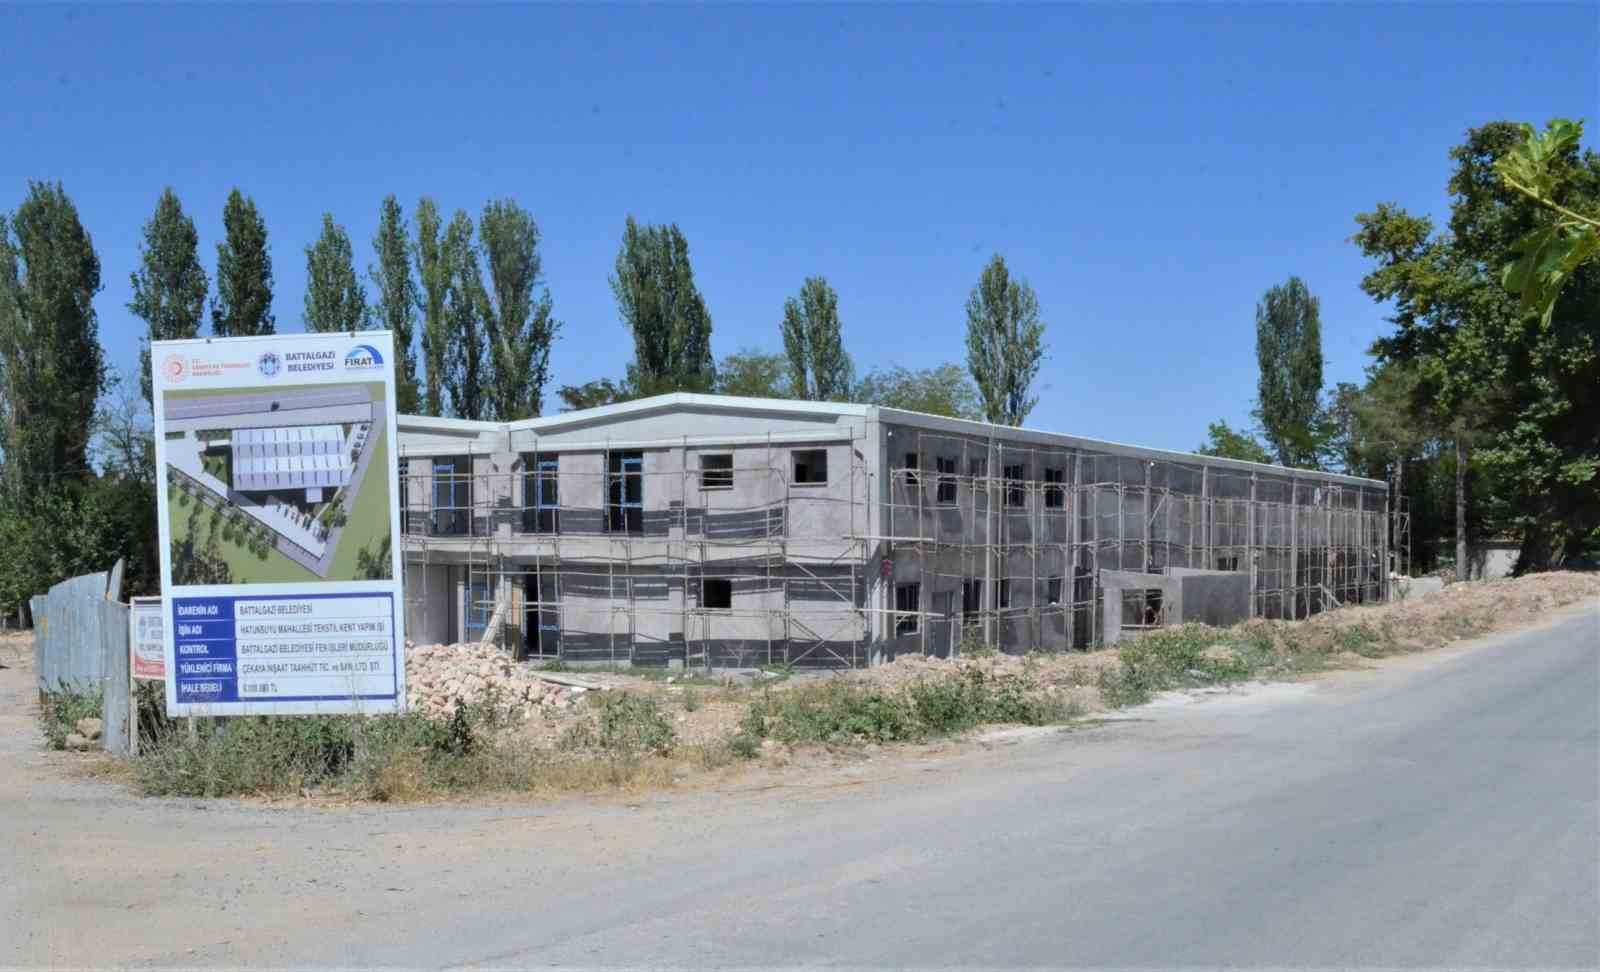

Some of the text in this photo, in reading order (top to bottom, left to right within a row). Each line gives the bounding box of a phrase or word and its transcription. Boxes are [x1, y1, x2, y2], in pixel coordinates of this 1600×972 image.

[344, 357, 372, 367] FIRAT
[207, 605, 218, 615] ADI
[192, 624, 202, 634] ADI
[340, 623, 356, 632] KENT
[180, 645, 208, 655] KONTROL
[315, 642, 328, 652] FEN
